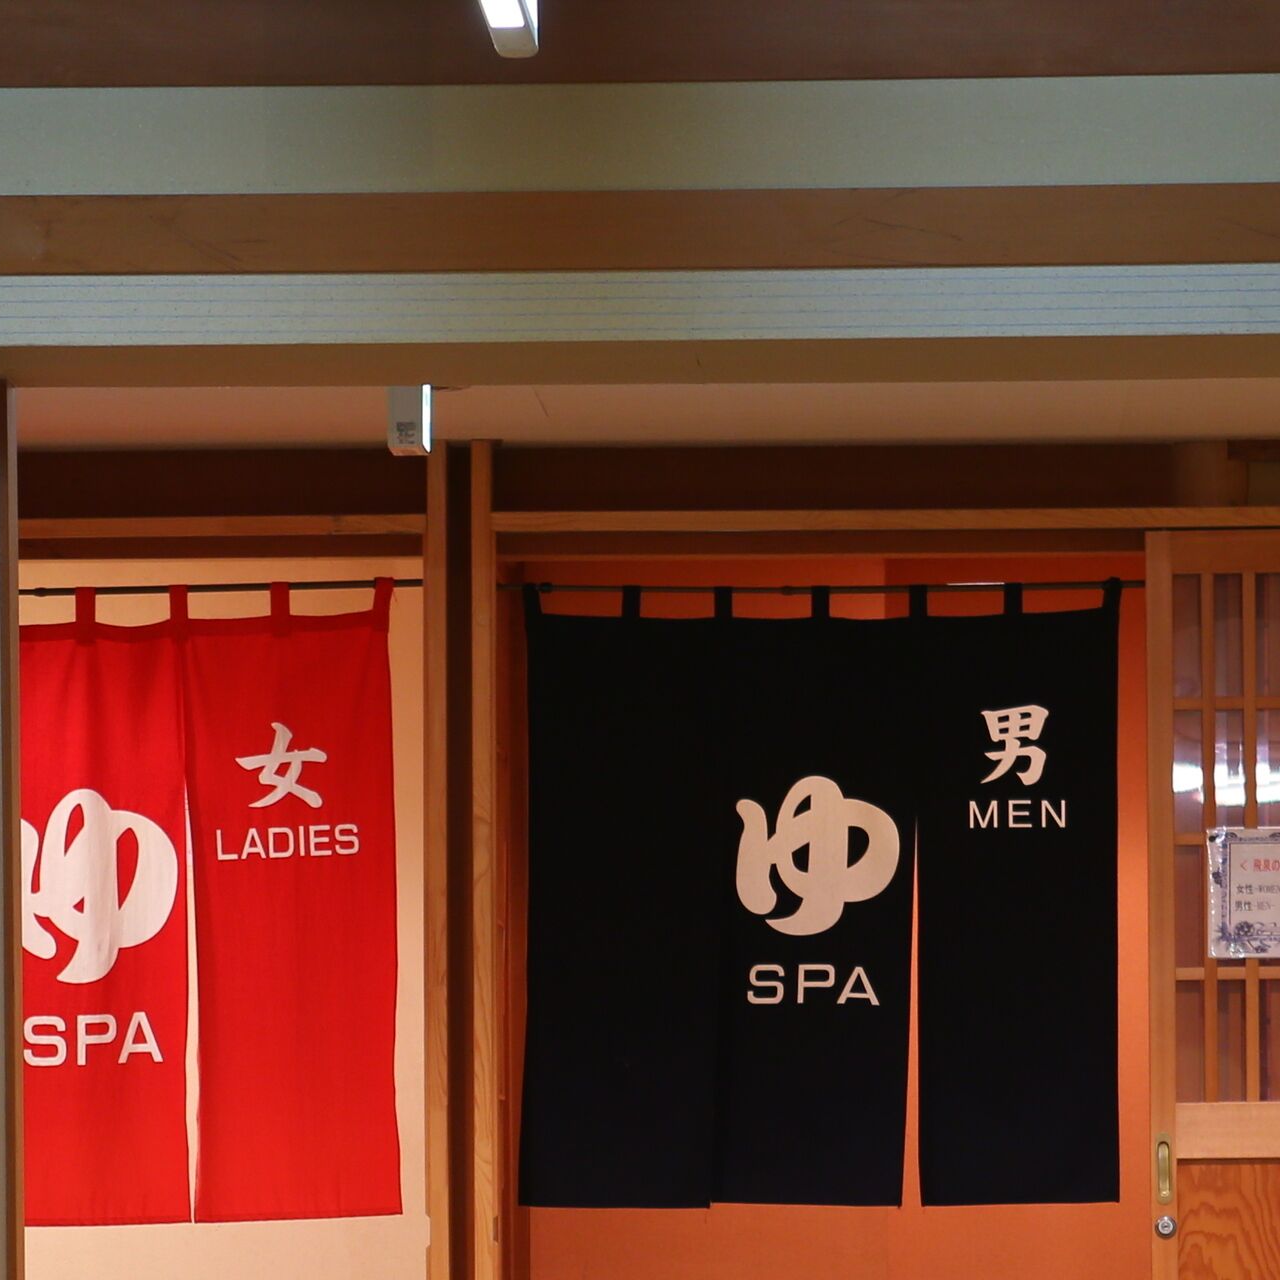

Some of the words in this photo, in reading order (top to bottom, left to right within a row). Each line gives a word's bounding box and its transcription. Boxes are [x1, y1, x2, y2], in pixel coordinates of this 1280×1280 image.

[235, 722, 328, 808] 女
[980, 704, 1049, 786] 男
[216, 823, 360, 861] LADIES
[969, 799, 1066, 829] MEN
[20, 788, 179, 984] ゆ
[735, 775, 900, 936] ゆ
[747, 964, 880, 1006] SPA
[22, 1011, 164, 1067] SPA
